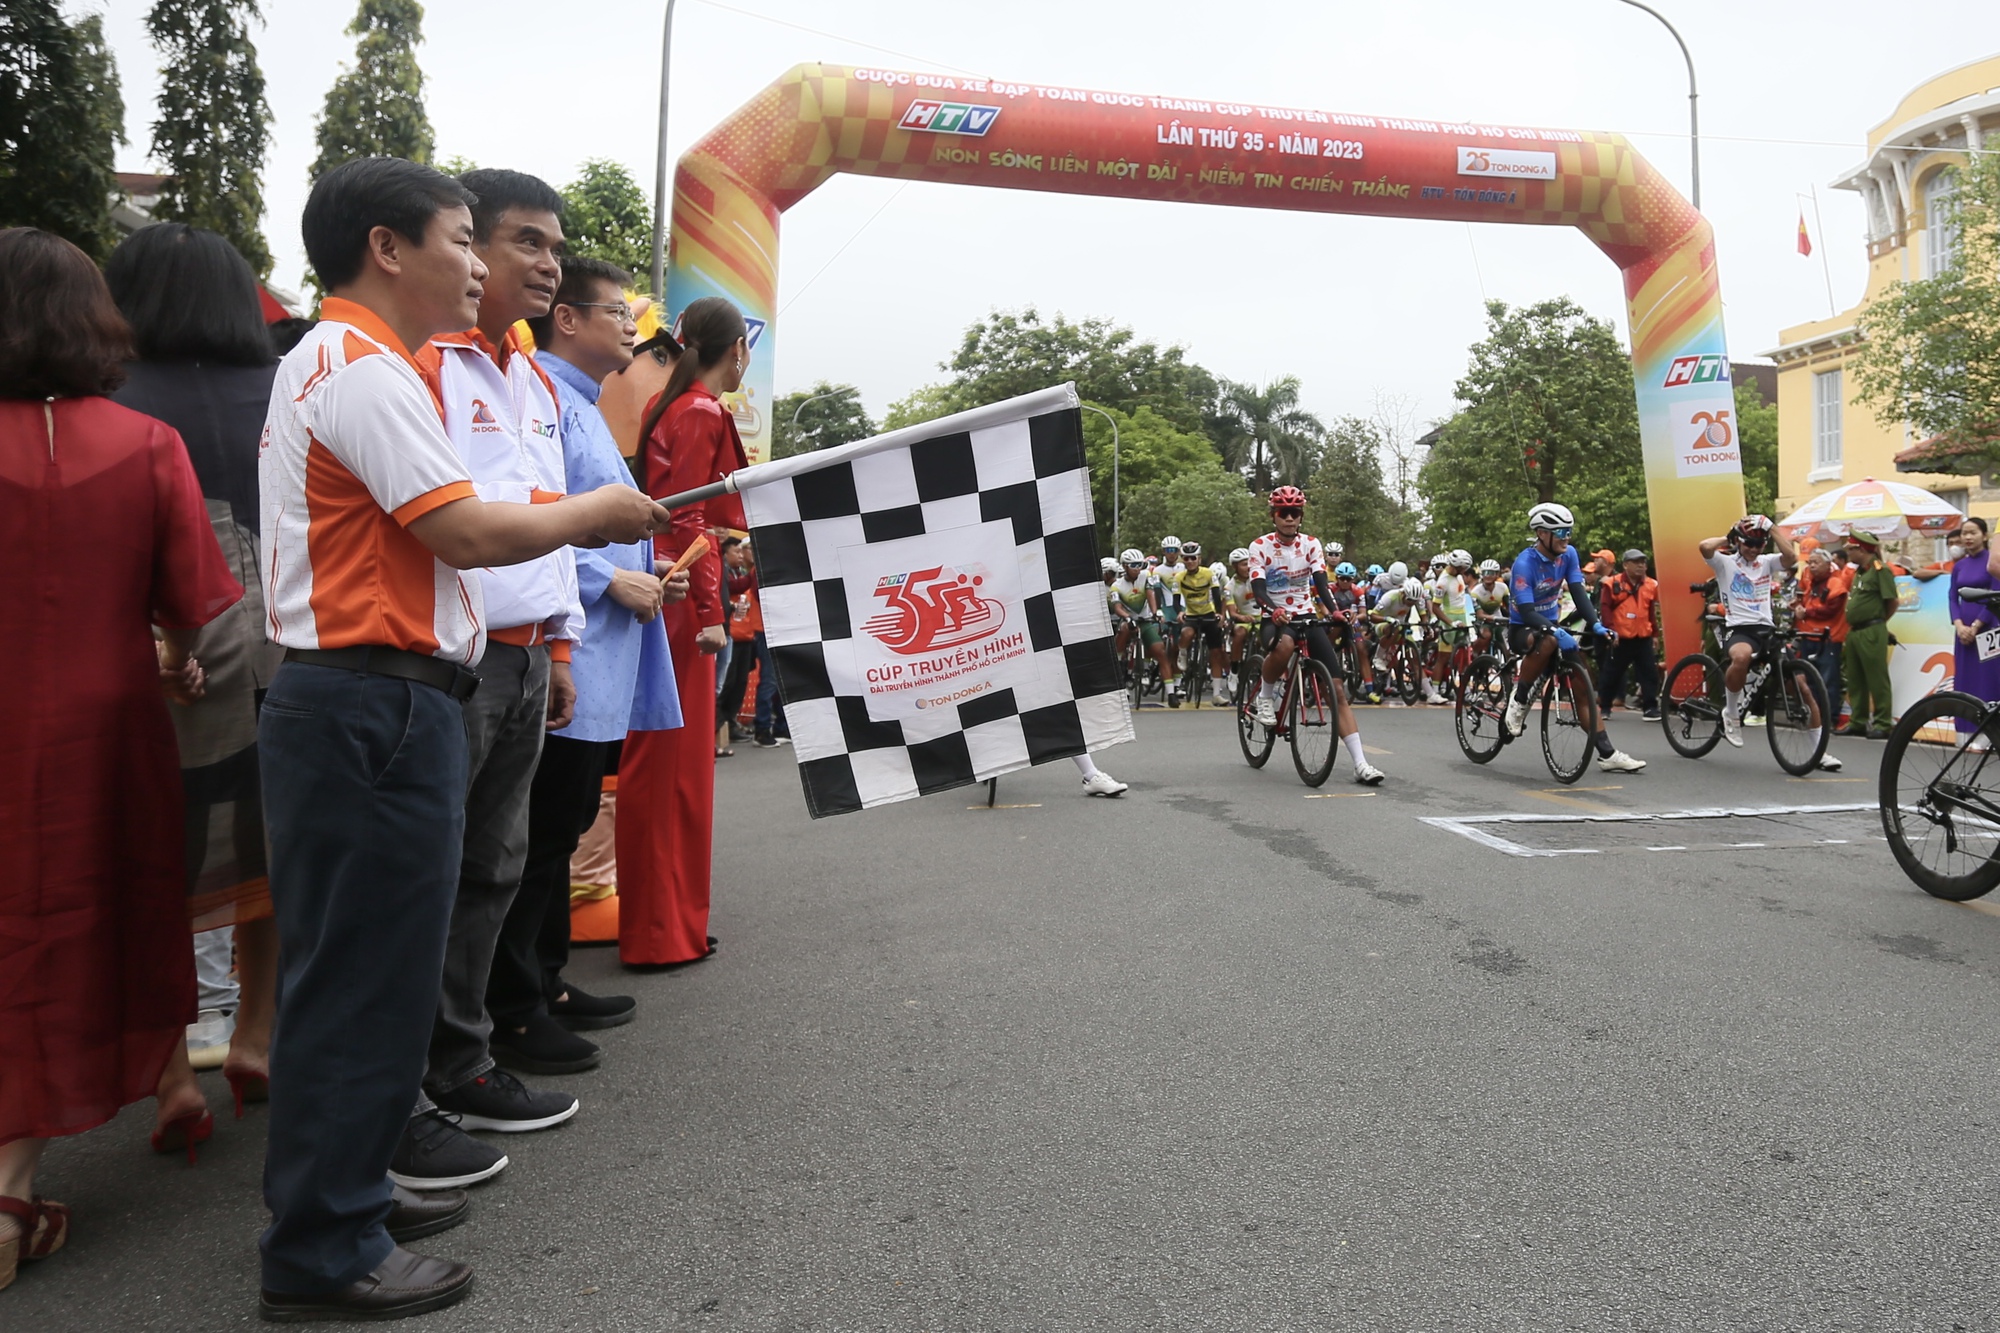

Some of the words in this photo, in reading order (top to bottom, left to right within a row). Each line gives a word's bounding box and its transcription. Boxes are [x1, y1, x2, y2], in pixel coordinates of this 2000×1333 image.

[901, 101, 998, 133] HTV
[915, 75, 956, 89] ĐUA
[961, 79, 987, 92] XE
[991, 82, 1030, 99] ĐẠP
[1148, 97, 1212, 113] TRANH
[1539, 130, 1583, 143] MINH
[1157, 119, 1193, 145] LẦN
[1198, 126, 1238, 149] THỨ
[1243, 132, 1264, 151] 35
[1279, 131, 1318, 156] NĂM
[1323, 139, 1363, 159] 2023
[936, 148, 979, 164] NON
[988, 148, 1042, 172] SÔNG
[1096, 157, 1140, 180] MỘT
[1254, 172, 1284, 188] TIN
[1290, 171, 1344, 193] CHIẾN
[1352, 175, 1411, 199] THẮNG
[1466, 151, 1490, 172] 25
[1491, 163, 1511, 172] TON
[1512, 164, 1540, 174] DONG
[1540, 166, 1548, 174] A
[1421, 186, 1445, 198] HTV
[1690, 410, 1733, 449] 25
[1684, 455, 1709, 465] TON
[878, 573, 907, 587] HTV
[866, 663, 903, 683] CÚP
[907, 647, 979, 677] TRUYỀN
[984, 632, 1024, 656] HÌNH
[870, 684, 884, 694] ĐÀI
[914, 677, 933, 687] HÌNH
[934, 670, 960, 682] THÀNH
[962, 661, 978, 674] PHỐ
[992, 652, 1006, 664] CHÍ
[1007, 647, 1026, 659] MINH
[929, 695, 952, 707] TON
[953, 684, 983, 700] DONG
[984, 681, 992, 690] A
